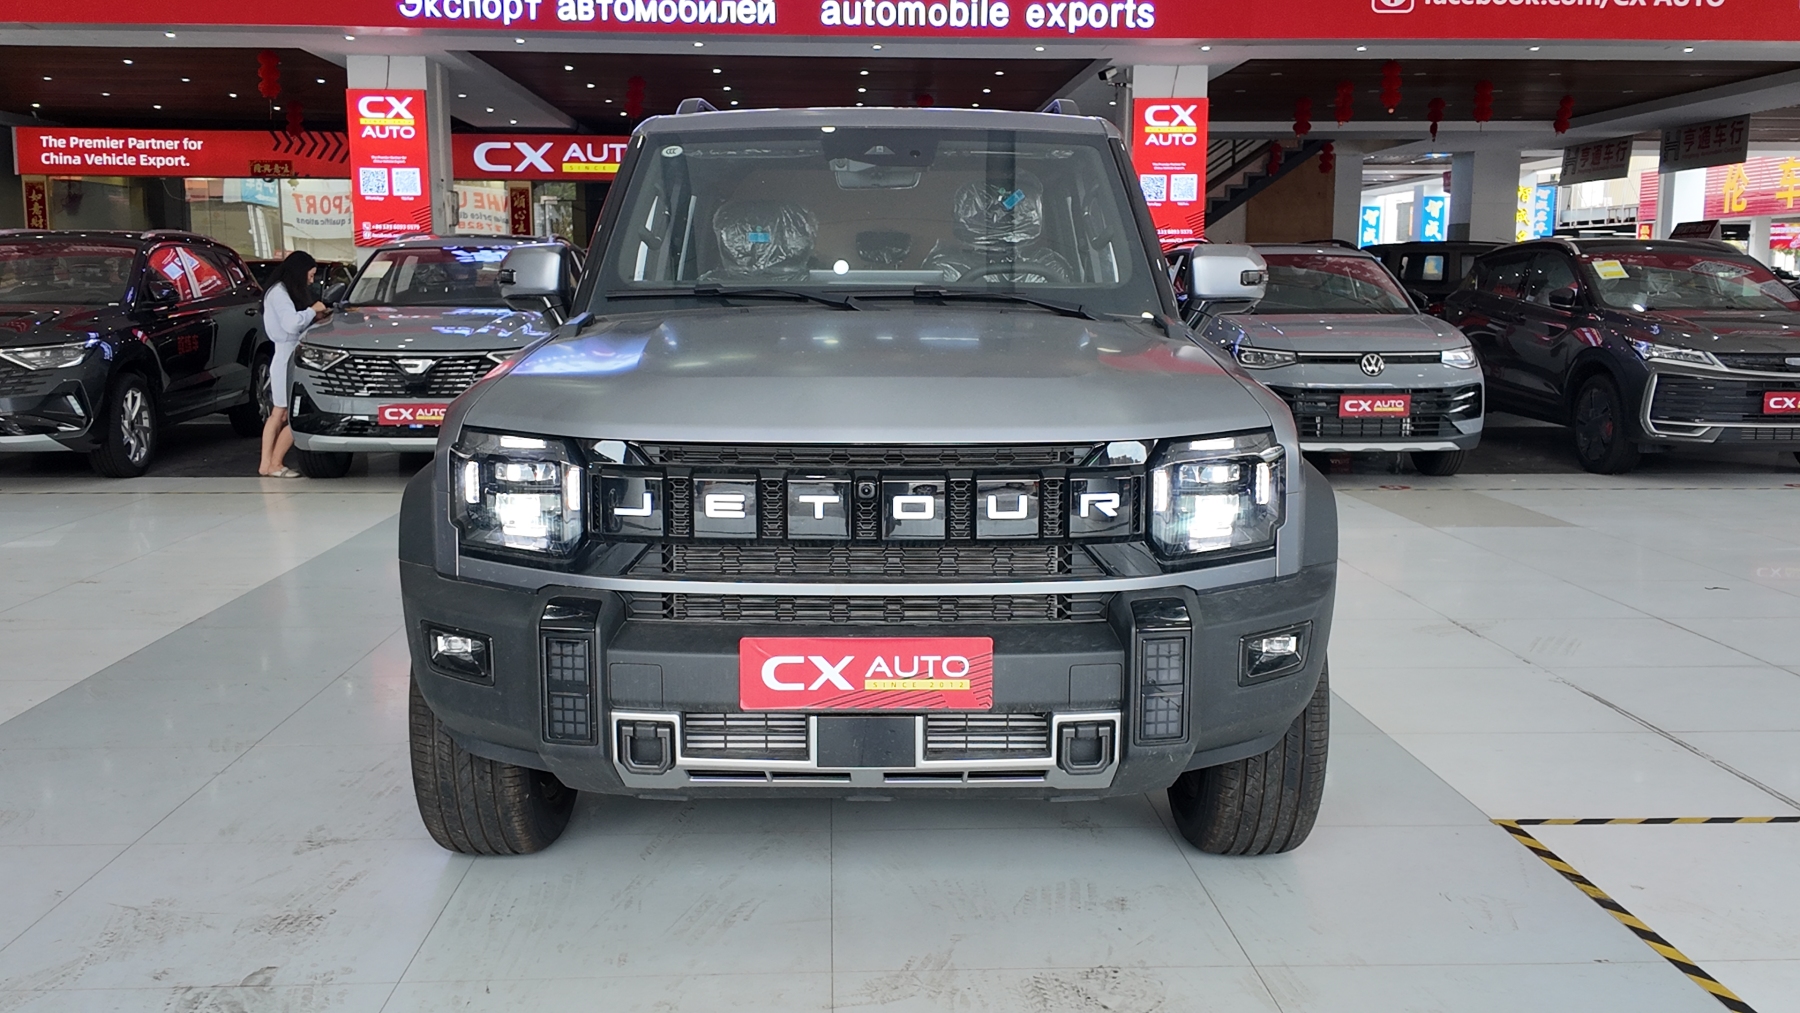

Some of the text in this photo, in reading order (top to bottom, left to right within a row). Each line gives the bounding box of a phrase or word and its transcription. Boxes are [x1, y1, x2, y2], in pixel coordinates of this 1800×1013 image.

[557, 0, 777, 25] автомобилей
[819, 0, 1156, 33] automobile exports
[357, 95, 414, 119] CX
[1144, 104, 1198, 127] CX
[361, 125, 416, 139] AUTO
[1144, 133, 1197, 146] AUTO
[40, 135, 203, 150] The Premier Partner for
[41, 152, 190, 168] China Vehicle Export.
[473, 141, 628, 173] CX AUT
[1344, 399, 1372, 412] CX
[1374, 400, 1404, 408] AUTO
[1769, 397, 1797, 409] CX
[384, 407, 414, 420] CX
[613, 491, 1121, 521] JETOUR
[760, 655, 970, 691] CX AUTO
